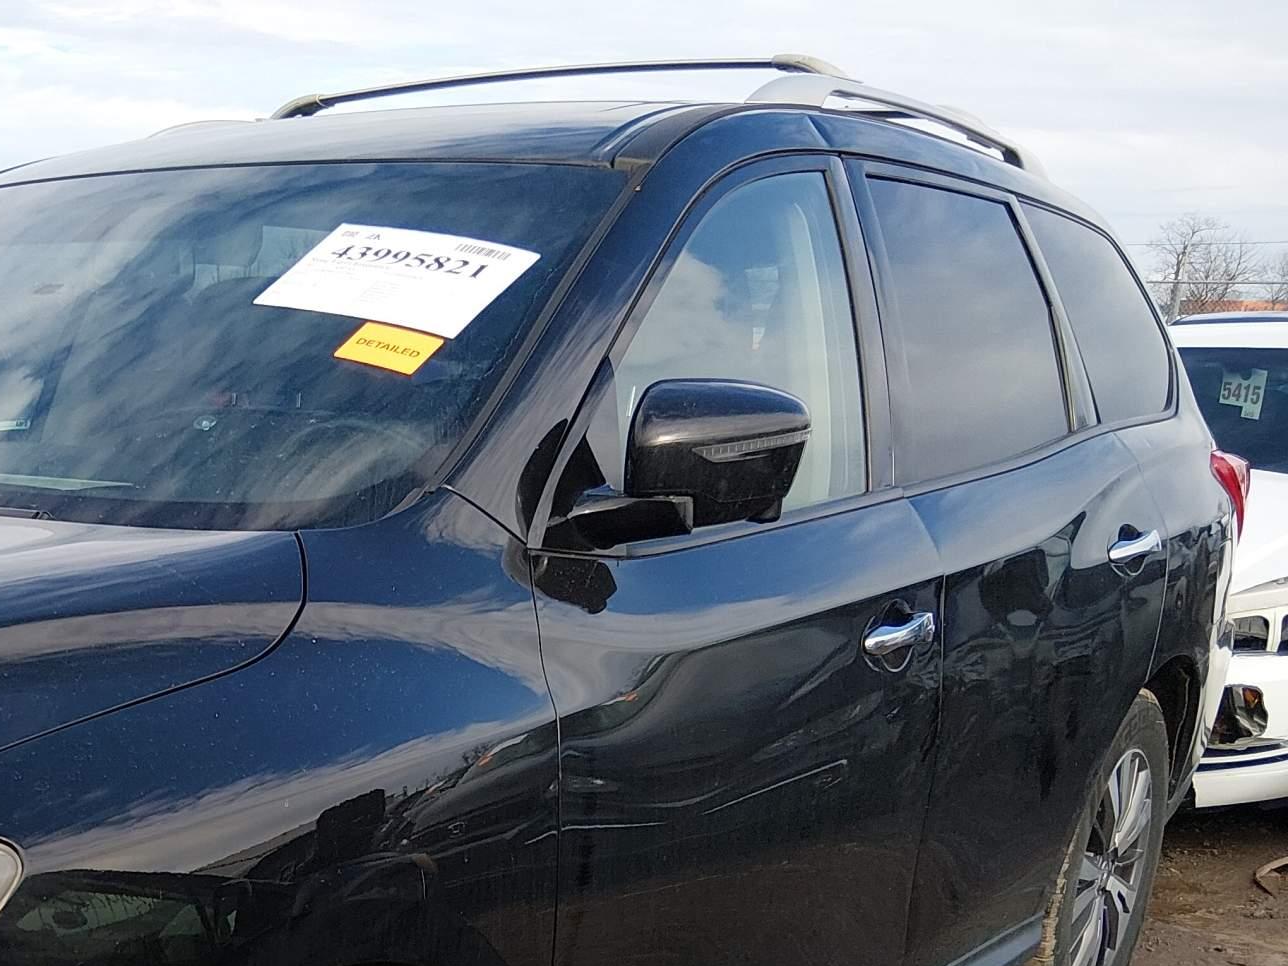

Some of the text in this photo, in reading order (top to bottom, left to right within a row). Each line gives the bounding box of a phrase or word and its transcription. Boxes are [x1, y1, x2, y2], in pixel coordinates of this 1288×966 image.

[331, 244, 489, 280] 43995821
[355, 337, 421, 358] DETAILED
[1221, 381, 1262, 405] 5415
